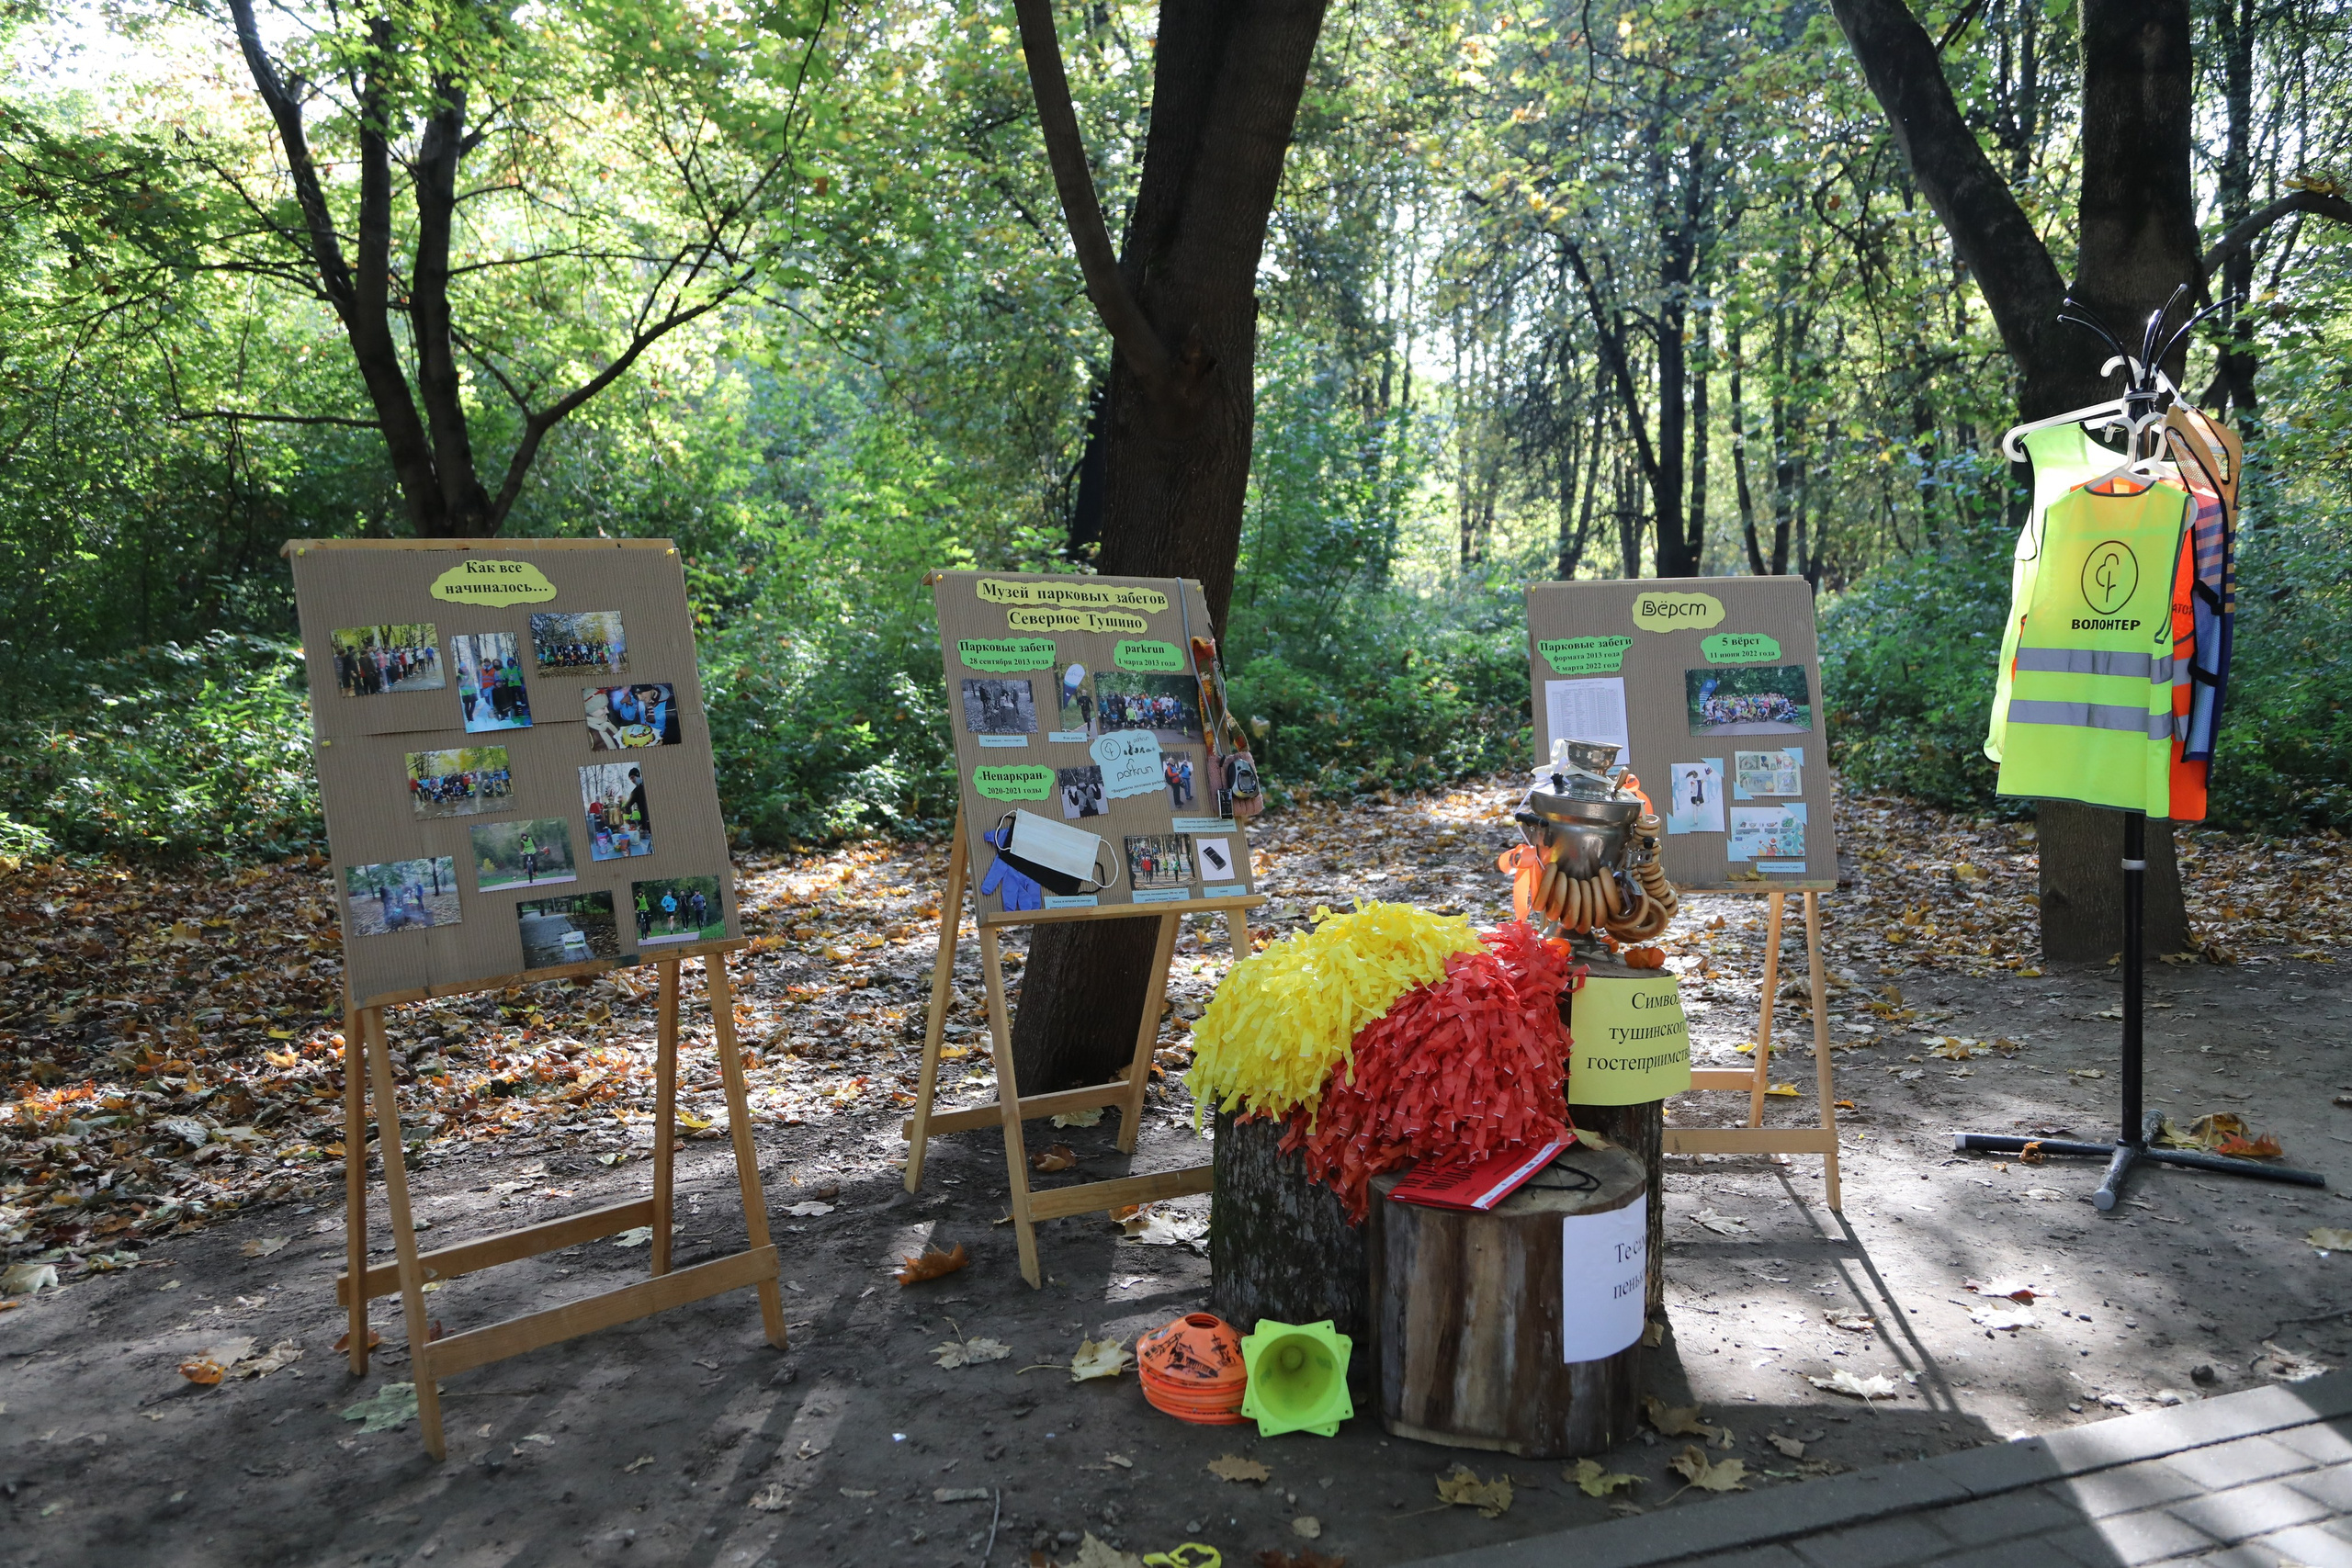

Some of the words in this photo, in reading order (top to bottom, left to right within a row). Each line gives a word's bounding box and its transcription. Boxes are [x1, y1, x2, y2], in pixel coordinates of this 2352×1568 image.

[466, 561, 496, 573] Как
[500, 564, 522, 573] все
[982, 582, 1029, 599] Музей
[1037, 590, 1110, 603] парковых
[1114, 592, 1166, 605] забегов
[1010, 611, 1080, 627] Северное
[1086, 614, 1143, 630] Тушино
[2071, 619, 2142, 631] ВОЛОНТЕР
[959, 641, 1017, 654] Парковые
[1018, 643, 1055, 652] забеги
[1540, 641, 1595, 653] Парковые
[1597, 637, 1632, 648] забеги
[1722, 637, 1728, 647] 5
[1731, 637, 1760, 647] вёрст
[1125, 644, 1165, 655] parkrun
[978, 658, 1012, 667] сентября
[1123, 659, 1144, 667] марта
[1144, 659, 1159, 667] 2013
[1553, 654, 1585, 662] формата
[1116, 758, 1154, 782] parkrun
[978, 771, 1047, 783] «Непаркран»
[1609, 1021, 1686, 1044] тушинског
[1587, 1048, 1690, 1074] гостеприимств
[1614, 1243, 1632, 1263] Те
[1613, 1268, 1645, 1300] пеньк
